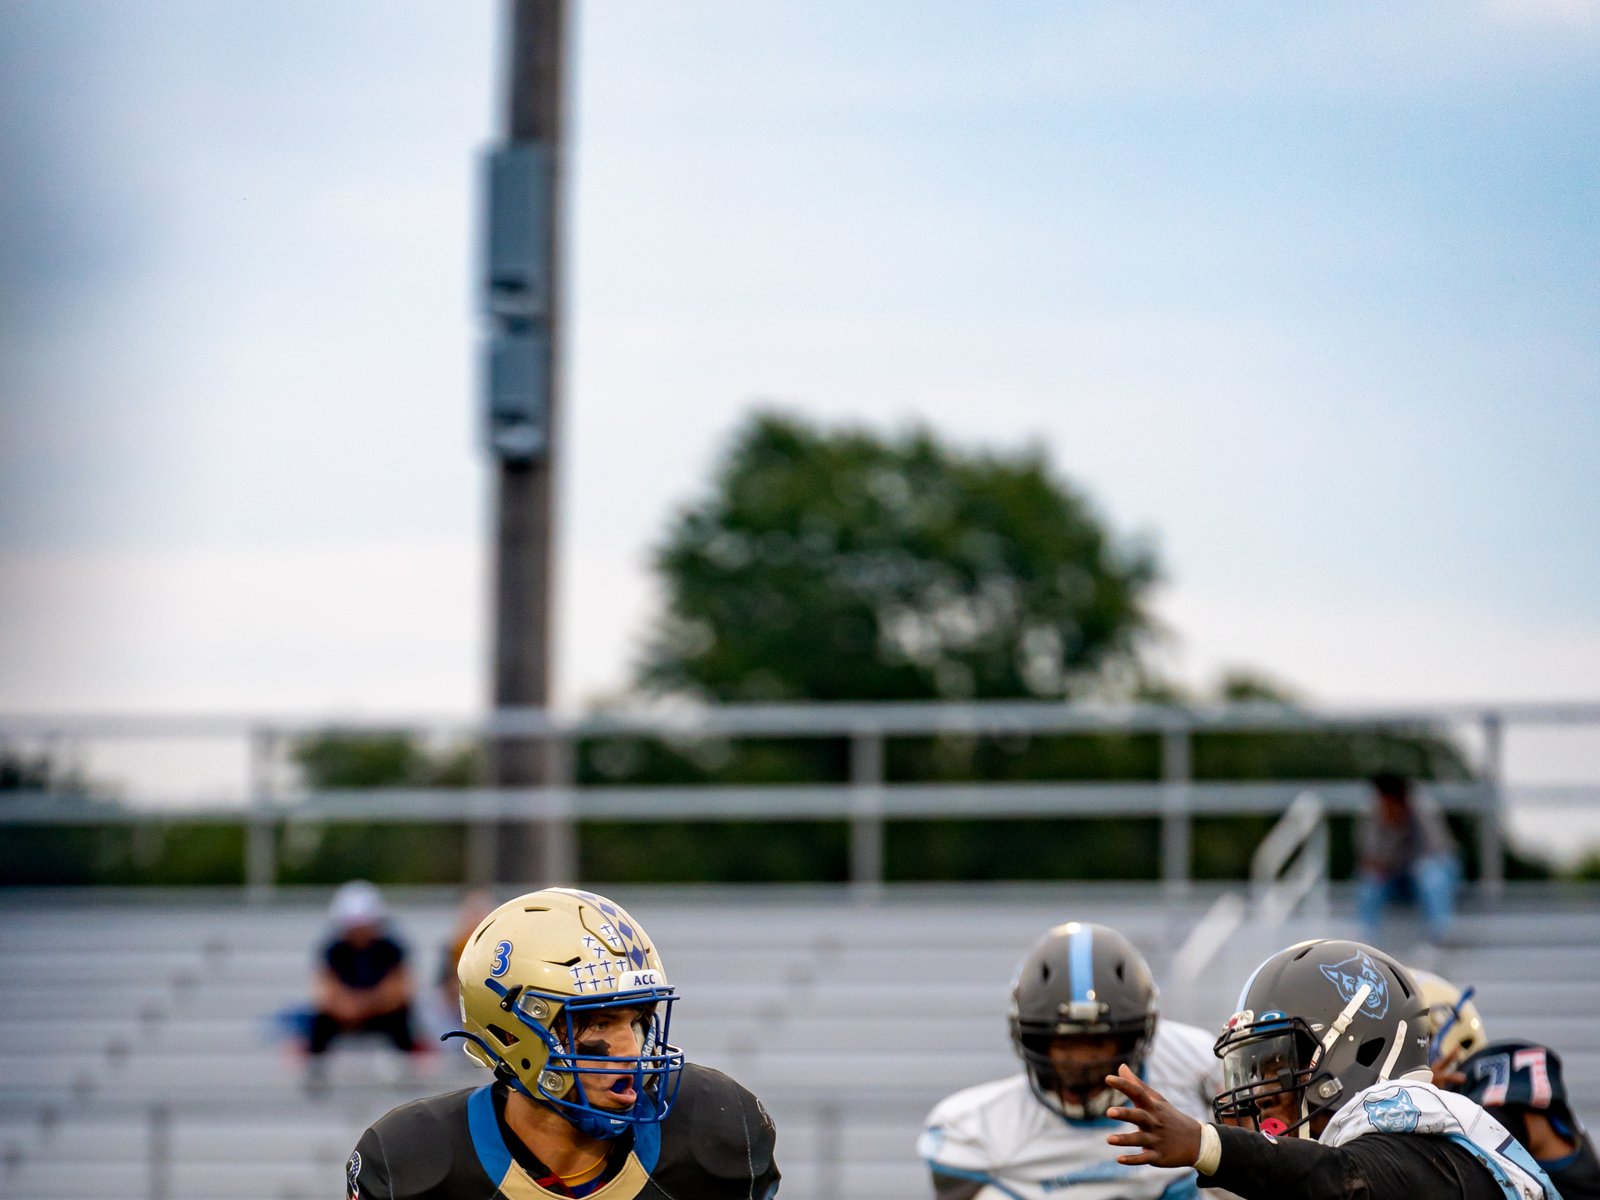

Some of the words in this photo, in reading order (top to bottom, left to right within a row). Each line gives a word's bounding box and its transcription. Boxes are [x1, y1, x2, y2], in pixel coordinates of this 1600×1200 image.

[489, 940, 513, 977] 3
[634, 974, 656, 986] ACC
[1474, 1047, 1552, 1109] 77
